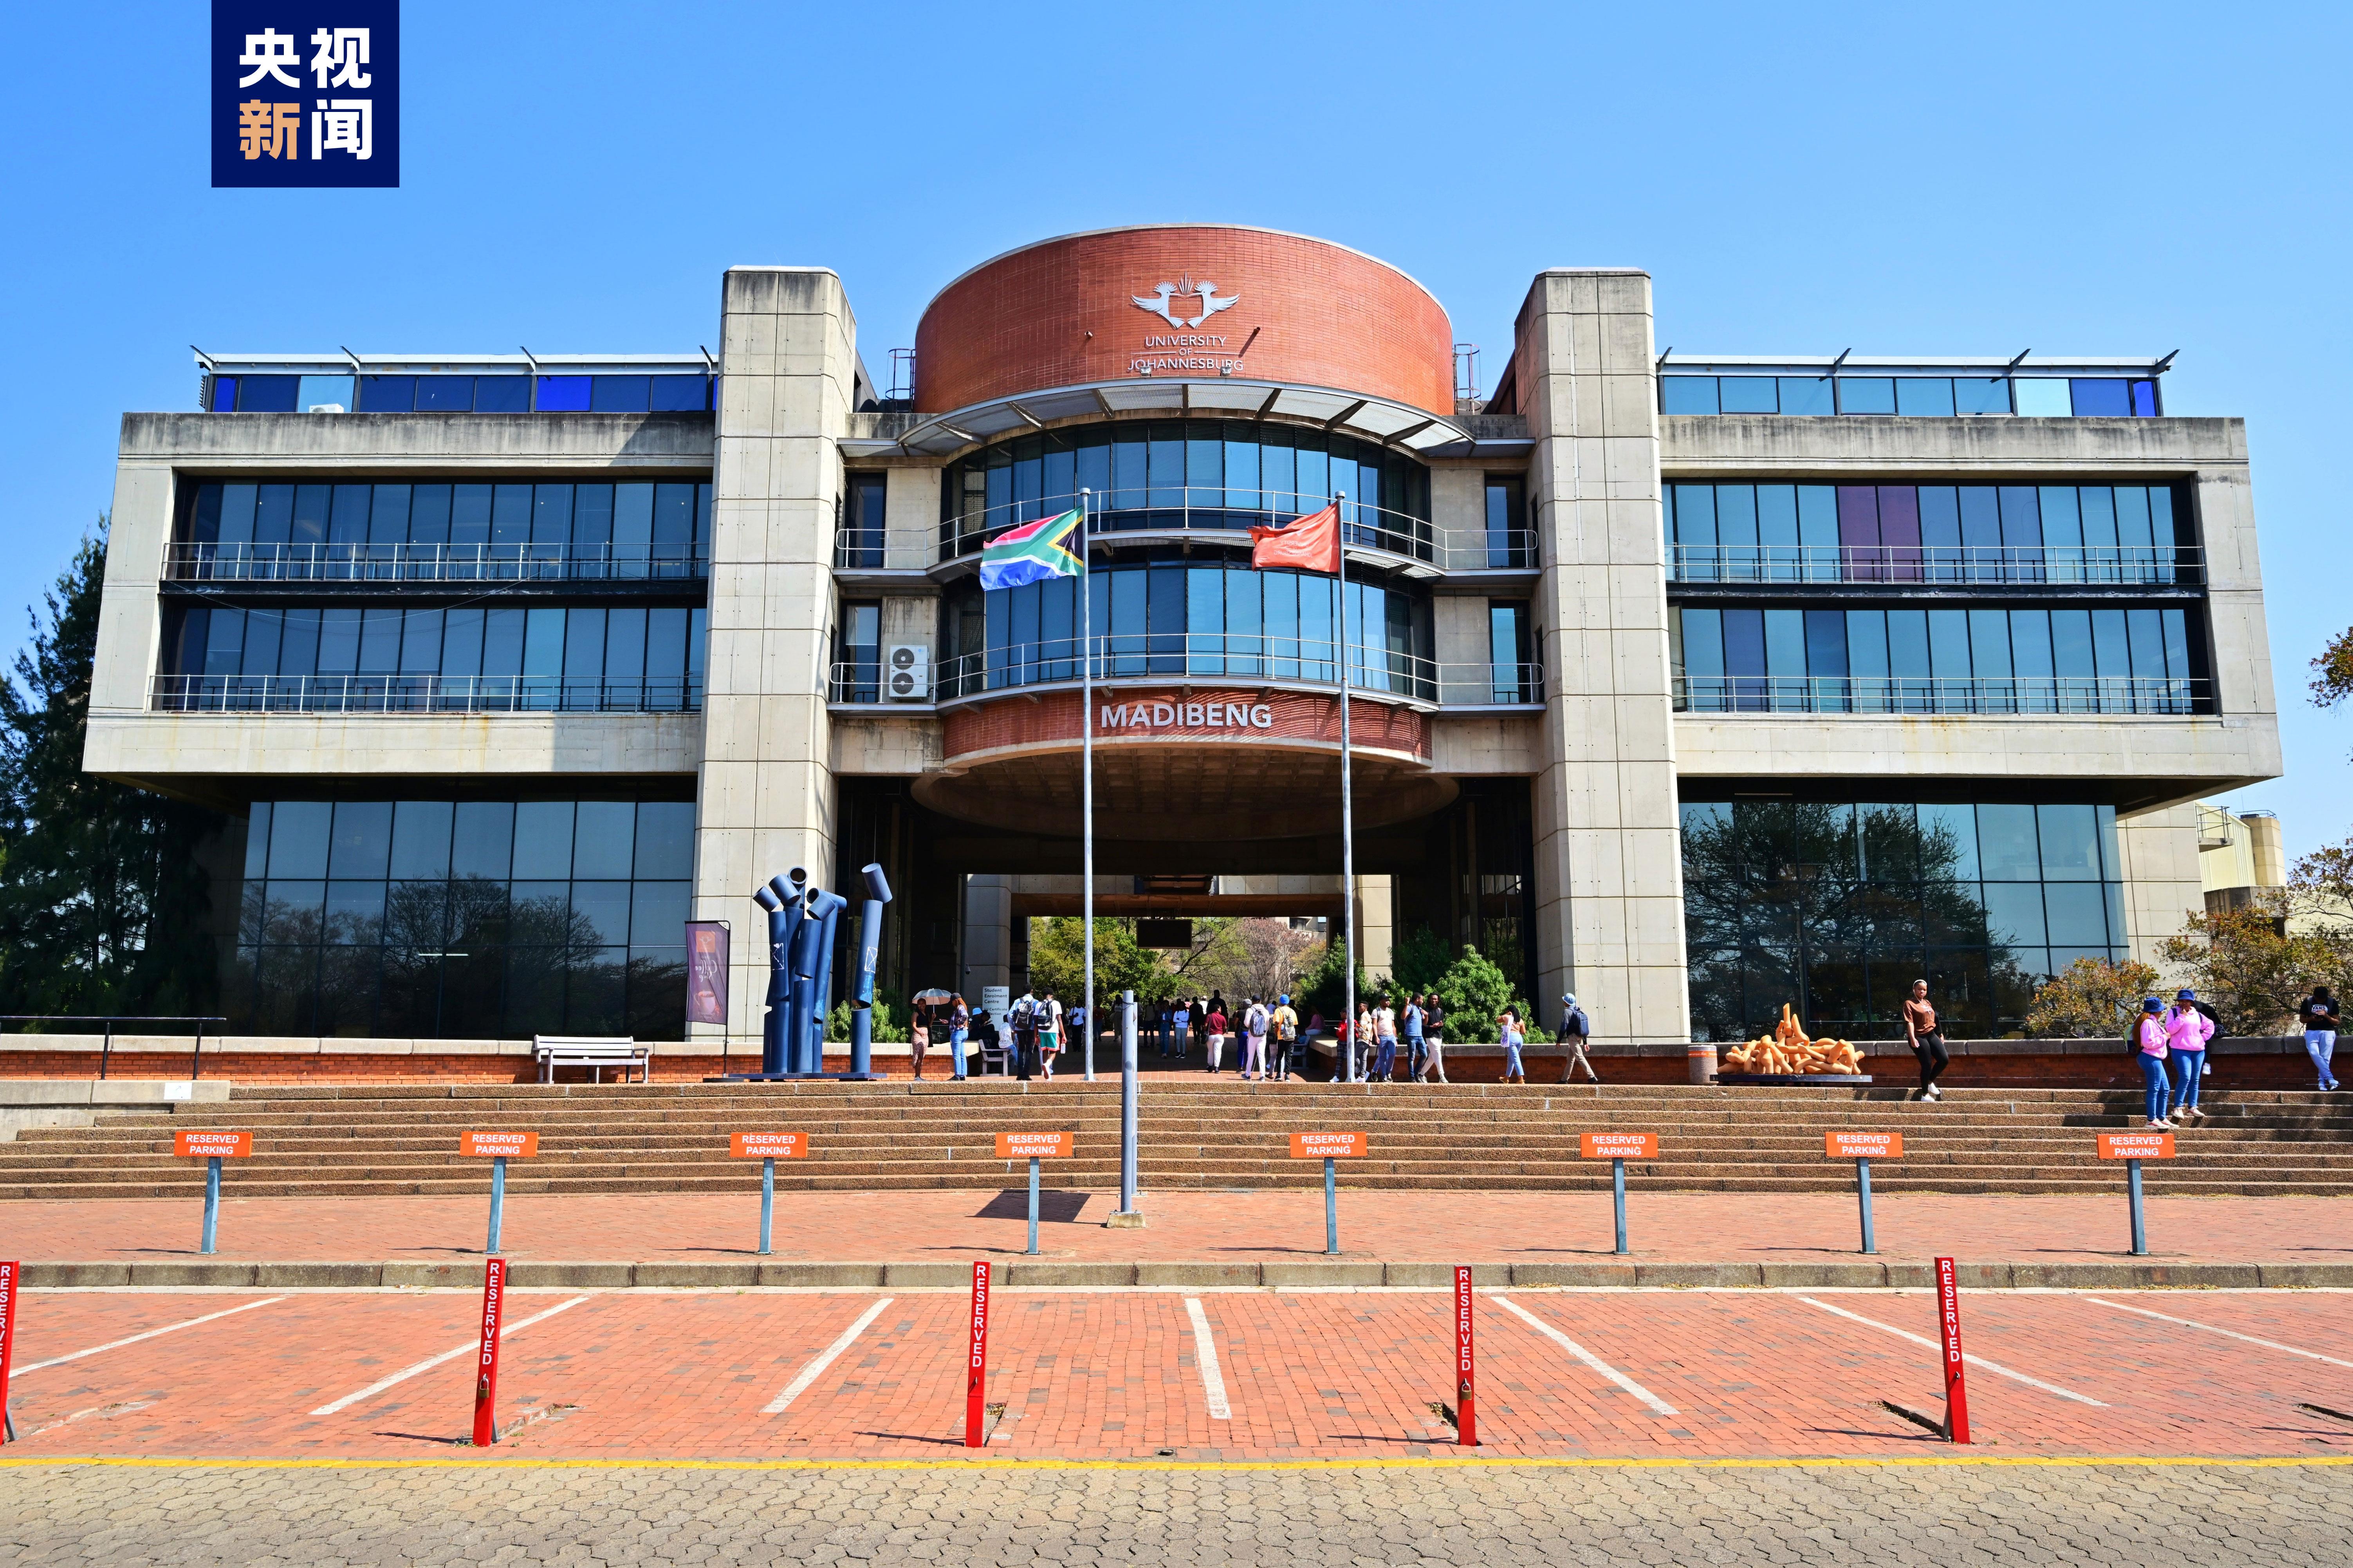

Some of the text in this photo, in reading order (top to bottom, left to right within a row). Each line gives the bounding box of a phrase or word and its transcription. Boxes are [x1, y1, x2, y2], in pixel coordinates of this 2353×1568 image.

[1146, 335, 1227, 346] UNIVERSITY
[1128, 358, 1243, 370] JOHANNESBURG
[1101, 703, 1272, 728] MADIBENG
[186, 1135, 239, 1143] RESERVED
[472, 1134, 526, 1143] RESERVED
[742, 1134, 796, 1143] RESERVED
[1007, 1134, 1061, 1143] RESERVED
[1302, 1135, 1355, 1144] RESERVED
[1837, 1135, 1891, 1143] RESERVED
[2109, 1137, 2163, 1145] RESERVED
[190, 1146, 233, 1154] PARKING
[476, 1146, 520, 1154] PARKING
[746, 1146, 791, 1155] PARKING
[1012, 1146, 1056, 1154] PARKING
[1306, 1146, 1351, 1155] PARKING
[1597, 1146, 1642, 1155] PARKING
[1842, 1146, 1886, 1154] PARKING
[2115, 1148, 2159, 1156] PARKING
[482, 1263, 500, 1364] RESERVED
[1942, 1260, 1960, 1362] RESERVED
[972, 1265, 986, 1367] RESERVED
[1459, 1269, 1471, 1371] RESERVED
